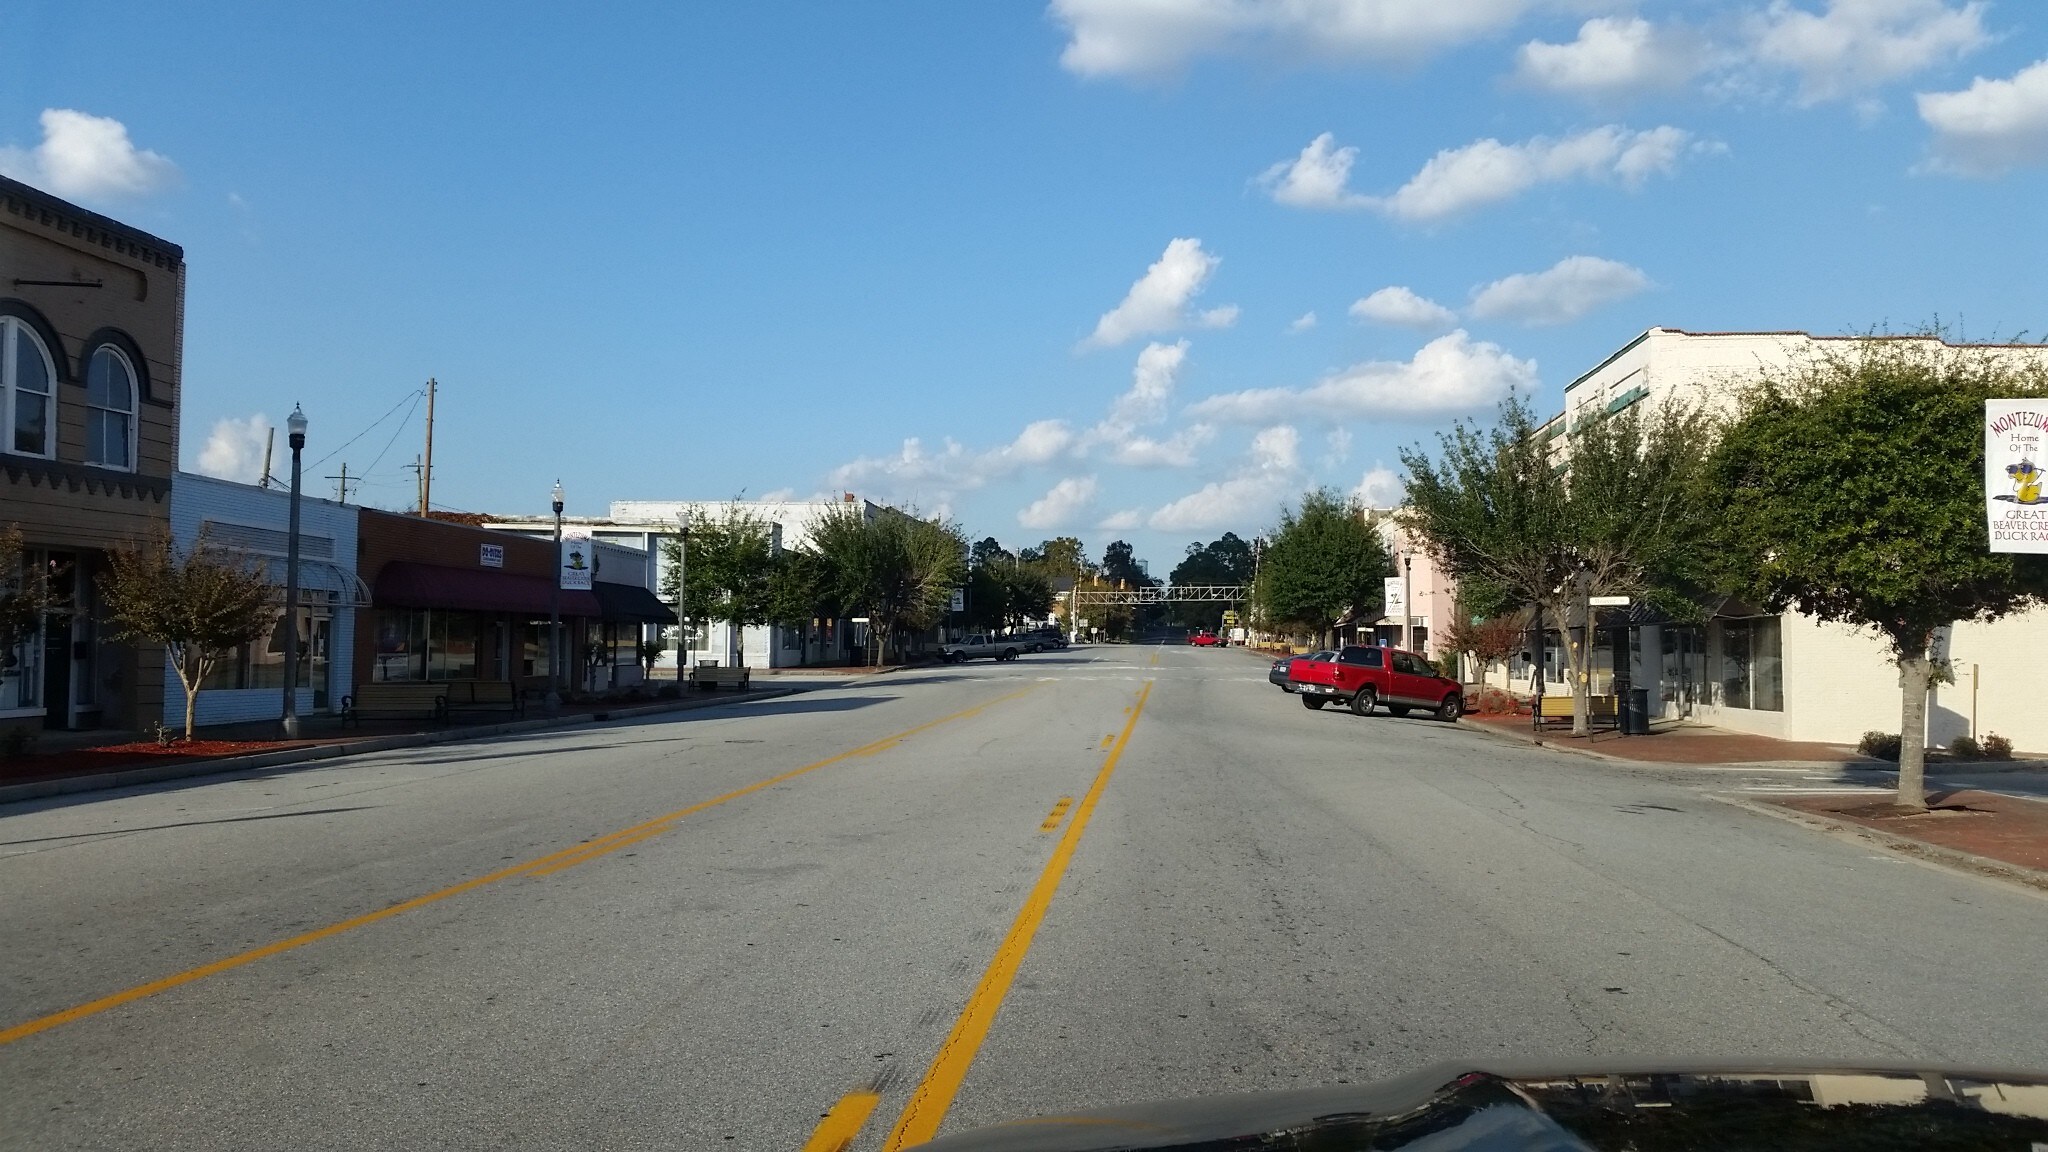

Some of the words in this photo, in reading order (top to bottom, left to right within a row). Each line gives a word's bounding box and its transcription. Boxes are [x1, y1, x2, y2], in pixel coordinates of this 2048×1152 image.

[2011, 433, 2040, 442] Home
[2010, 444, 2021, 453] Of
[2023, 444, 2039, 452] The
[2006, 509, 2047, 520] GREAT
[1993, 520, 2029, 530] BEAVER
[1994, 530, 2028, 541] DUCK
